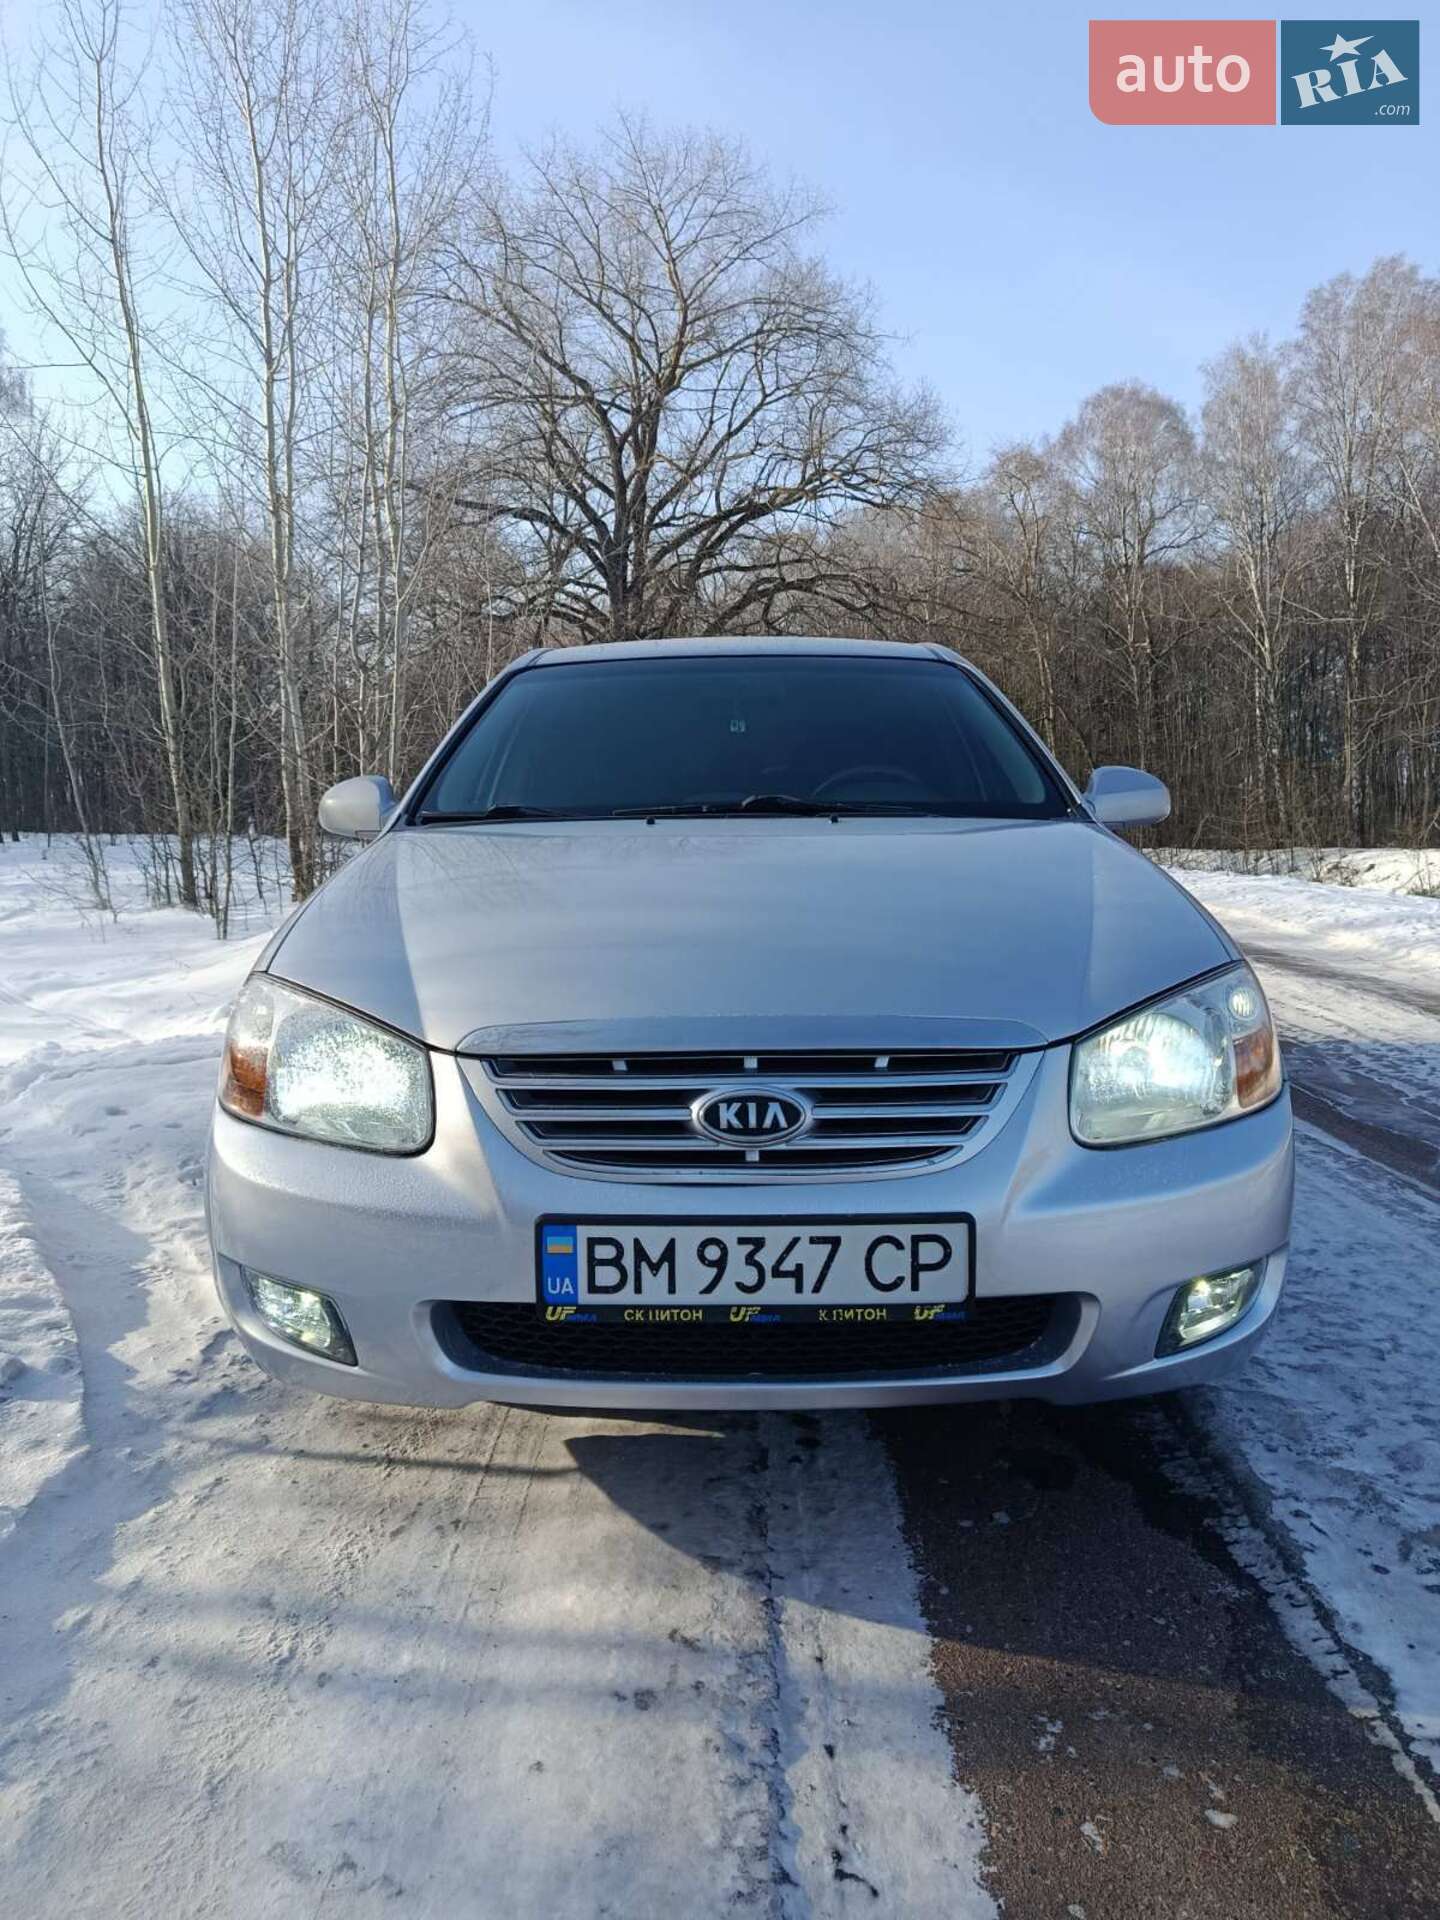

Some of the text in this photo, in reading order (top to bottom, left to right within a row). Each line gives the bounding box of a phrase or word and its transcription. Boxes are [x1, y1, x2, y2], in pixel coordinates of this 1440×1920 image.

[719, 1101, 788, 1129] KIA
[586, 1234, 952, 1294] BM 9347 CP
[547, 1277, 575, 1294] UA
